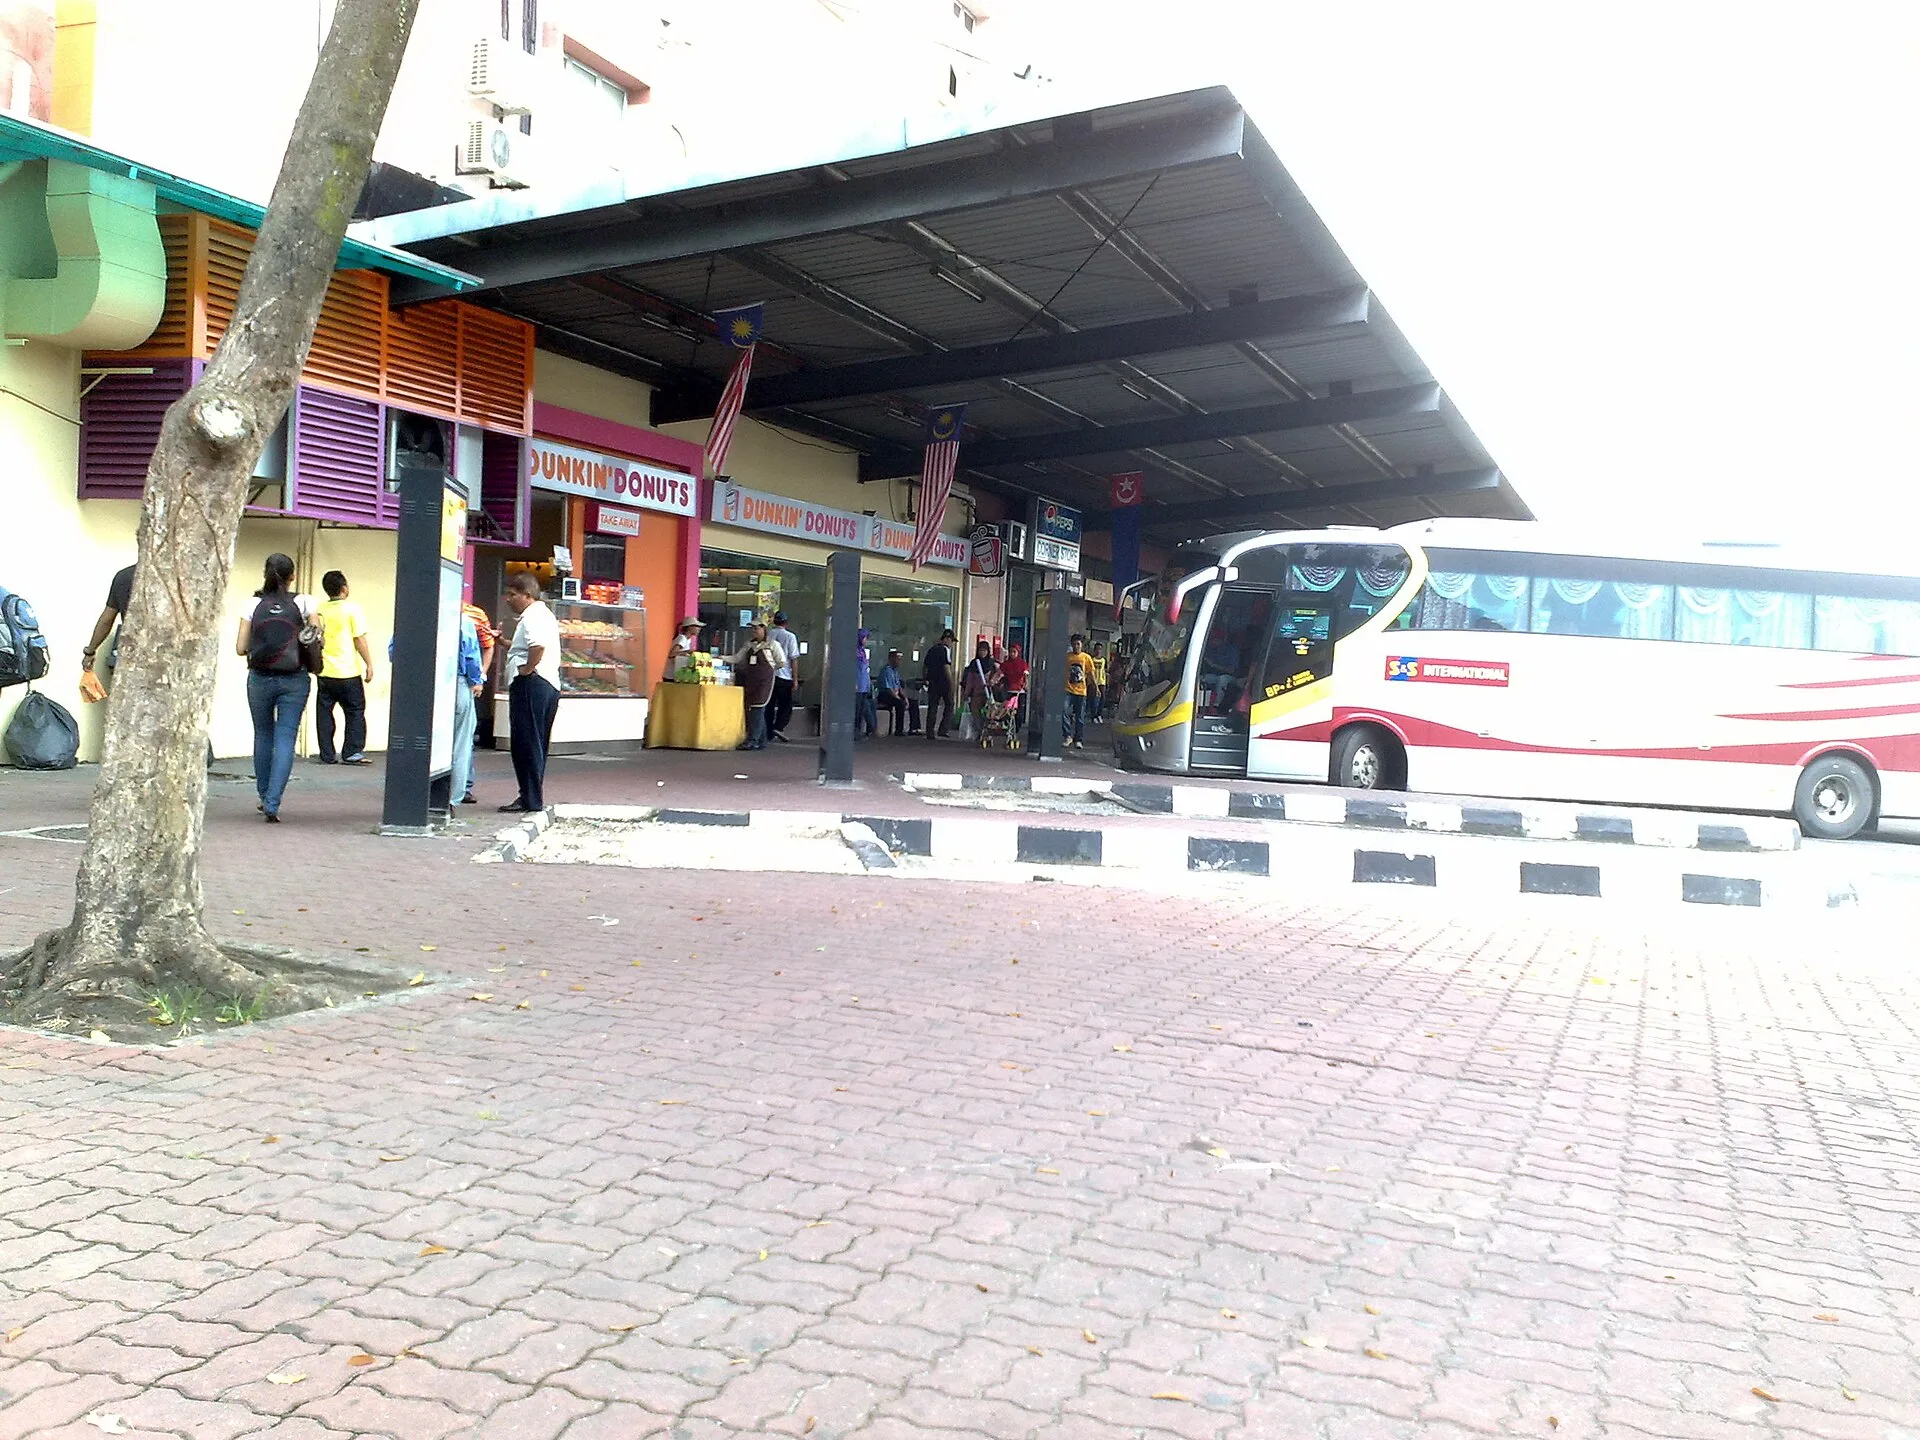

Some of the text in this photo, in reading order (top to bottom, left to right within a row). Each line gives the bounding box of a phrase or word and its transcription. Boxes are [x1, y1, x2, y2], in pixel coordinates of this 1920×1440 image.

[531, 448, 689, 507] DUNKIN' DONUTS
[601, 514, 637, 529] TAKE AWAY
[743, 496, 857, 541] DUNKIN' DONUTS
[884, 527, 965, 562] DUNK ONUTS
[1037, 540, 1078, 561] CORNER STORE
[1389, 660, 1508, 681] S&S INTERNATIONAL
